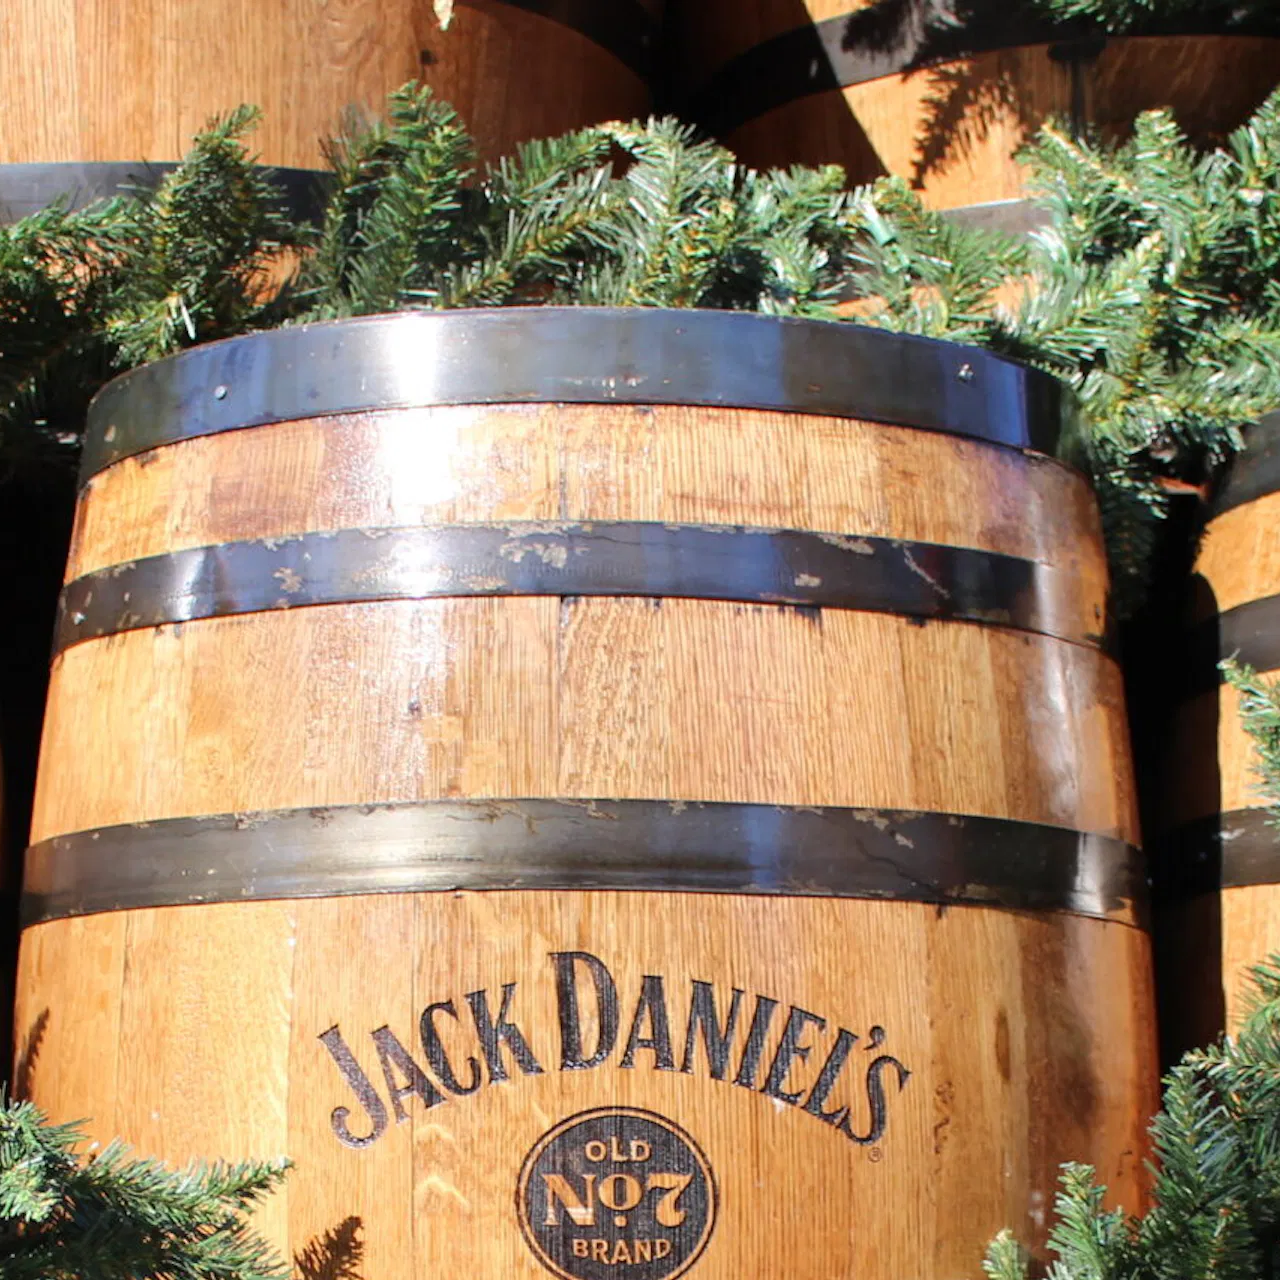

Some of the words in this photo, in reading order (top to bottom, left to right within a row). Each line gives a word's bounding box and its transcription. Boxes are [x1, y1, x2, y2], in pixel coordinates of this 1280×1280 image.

[317, 982, 543, 1148] JACK
[549, 951, 913, 1146] DANIEL'S
[585, 1137, 651, 1164] OLD
[573, 1237, 671, 1266] BRAND
